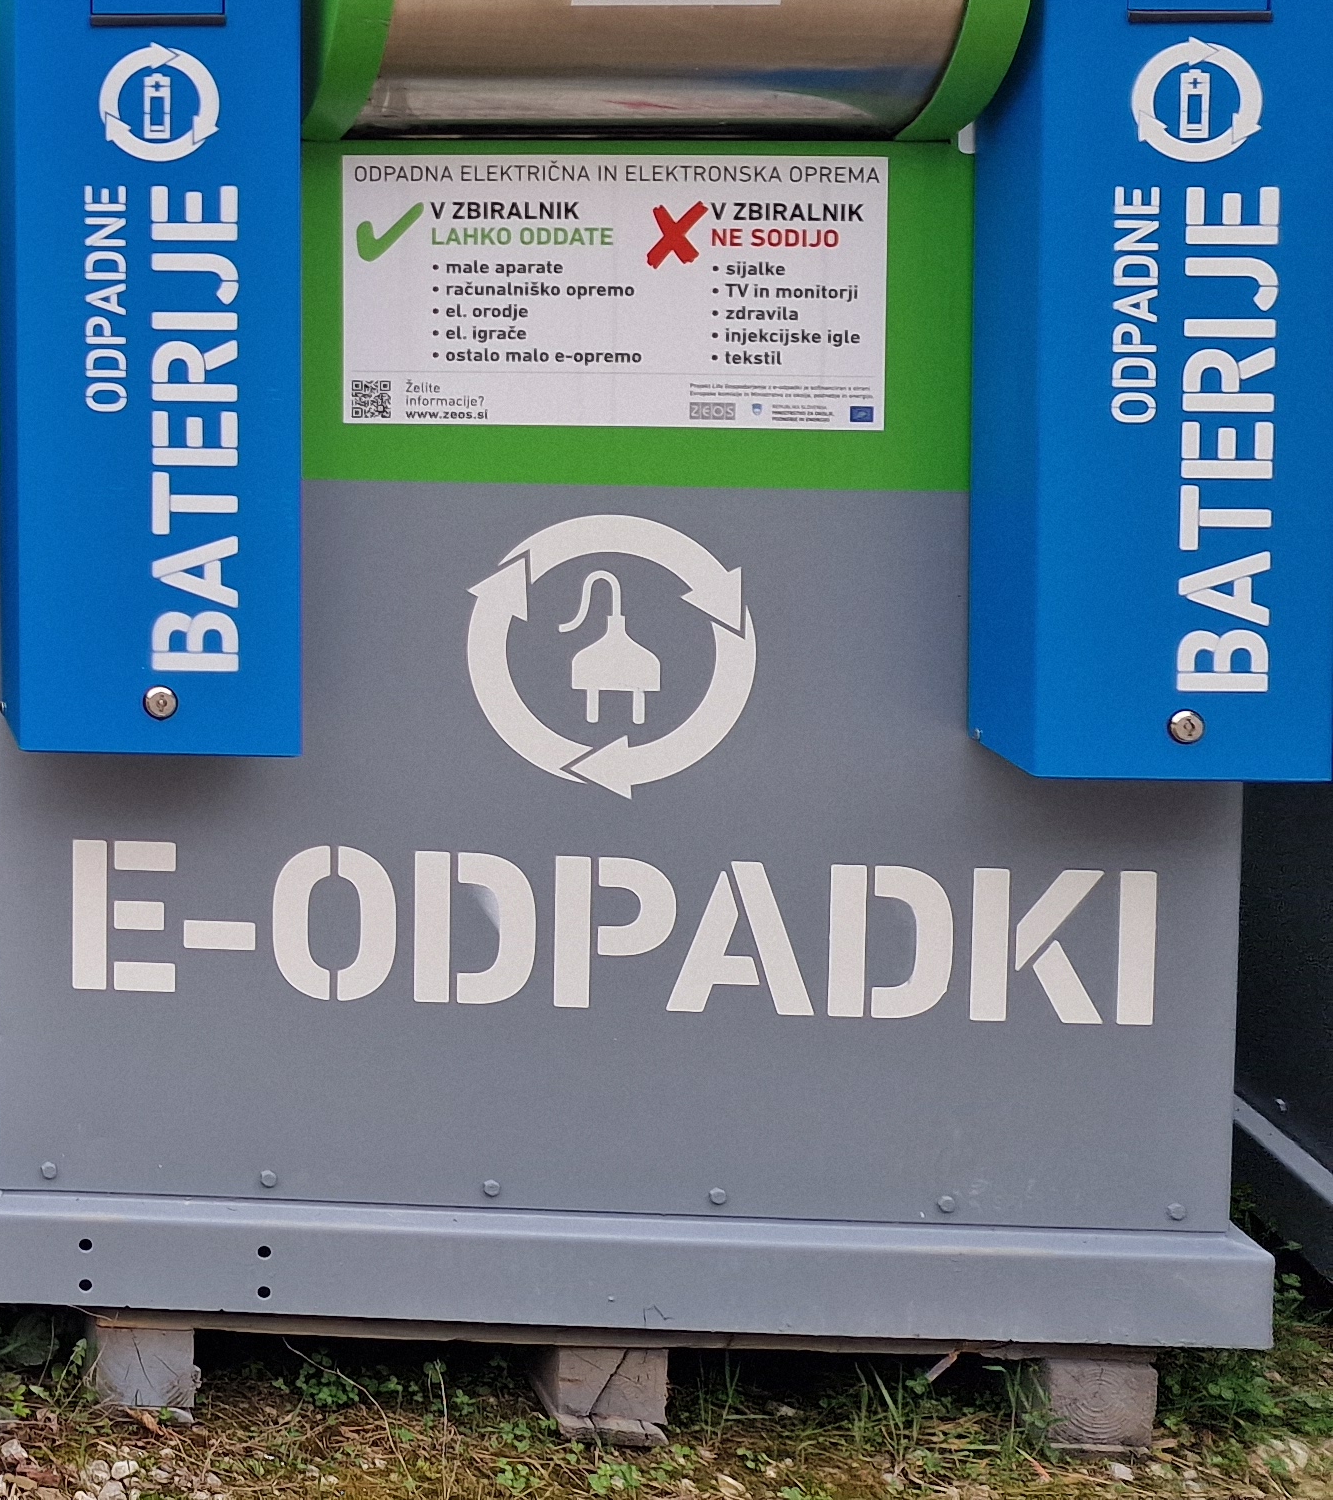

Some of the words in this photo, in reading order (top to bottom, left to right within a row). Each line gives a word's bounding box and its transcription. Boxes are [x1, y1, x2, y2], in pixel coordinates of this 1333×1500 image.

[354, 165, 454, 183] ODPADNA
[460, 160, 591, 182] ELEKTRIČNA
[598, 164, 617, 182] IN
[625, 164, 783, 183] ELEKTRONSKA
[789, 165, 880, 184] OPREMA
[430, 201, 446, 220] V
[452, 201, 579, 220] ZBIRALNIK
[710, 202, 727, 221] V
[733, 202, 864, 222] ZBIRALNIK
[431, 226, 512, 246] LAHKO
[519, 226, 614, 246] ODDATE
[711, 228, 743, 247] NE
[750, 228, 839, 248] SODIJO
[446, 259, 490, 274] male
[494, 260, 564, 278] aparate
[725, 260, 786, 279] sijalke
[84, 185, 128, 413] ODPADNE
[446, 281, 561, 297] računalniško
[566, 285, 635, 300] opremo
[724, 283, 750, 298] TV
[753, 283, 770, 299] in
[775, 284, 858, 303] monitorji
[445, 303, 467, 318] el.
[472, 303, 529, 322] orodje
[725, 305, 799, 321] zdravila
[1110, 186, 1160, 424] ODPADNE
[445, 325, 467, 340] el.
[472, 325, 527, 344] igrače
[725, 327, 822, 347] injekcijske
[827, 329, 861, 348] igle
[445, 347, 500, 362] ostalo
[505, 347, 550, 363] malo
[554, 351, 642, 367] e-opremo
[725, 350, 782, 366] tekstil
[405, 378, 441, 394] Želite
[405, 394, 485, 409] informacije?
[405, 408, 488, 420] www.zeos.si
[150, 185, 239, 673] BATERIJE
[1175, 186, 1280, 693] BATERIJE
[71, 839, 1157, 1026] E-ODPADKI
